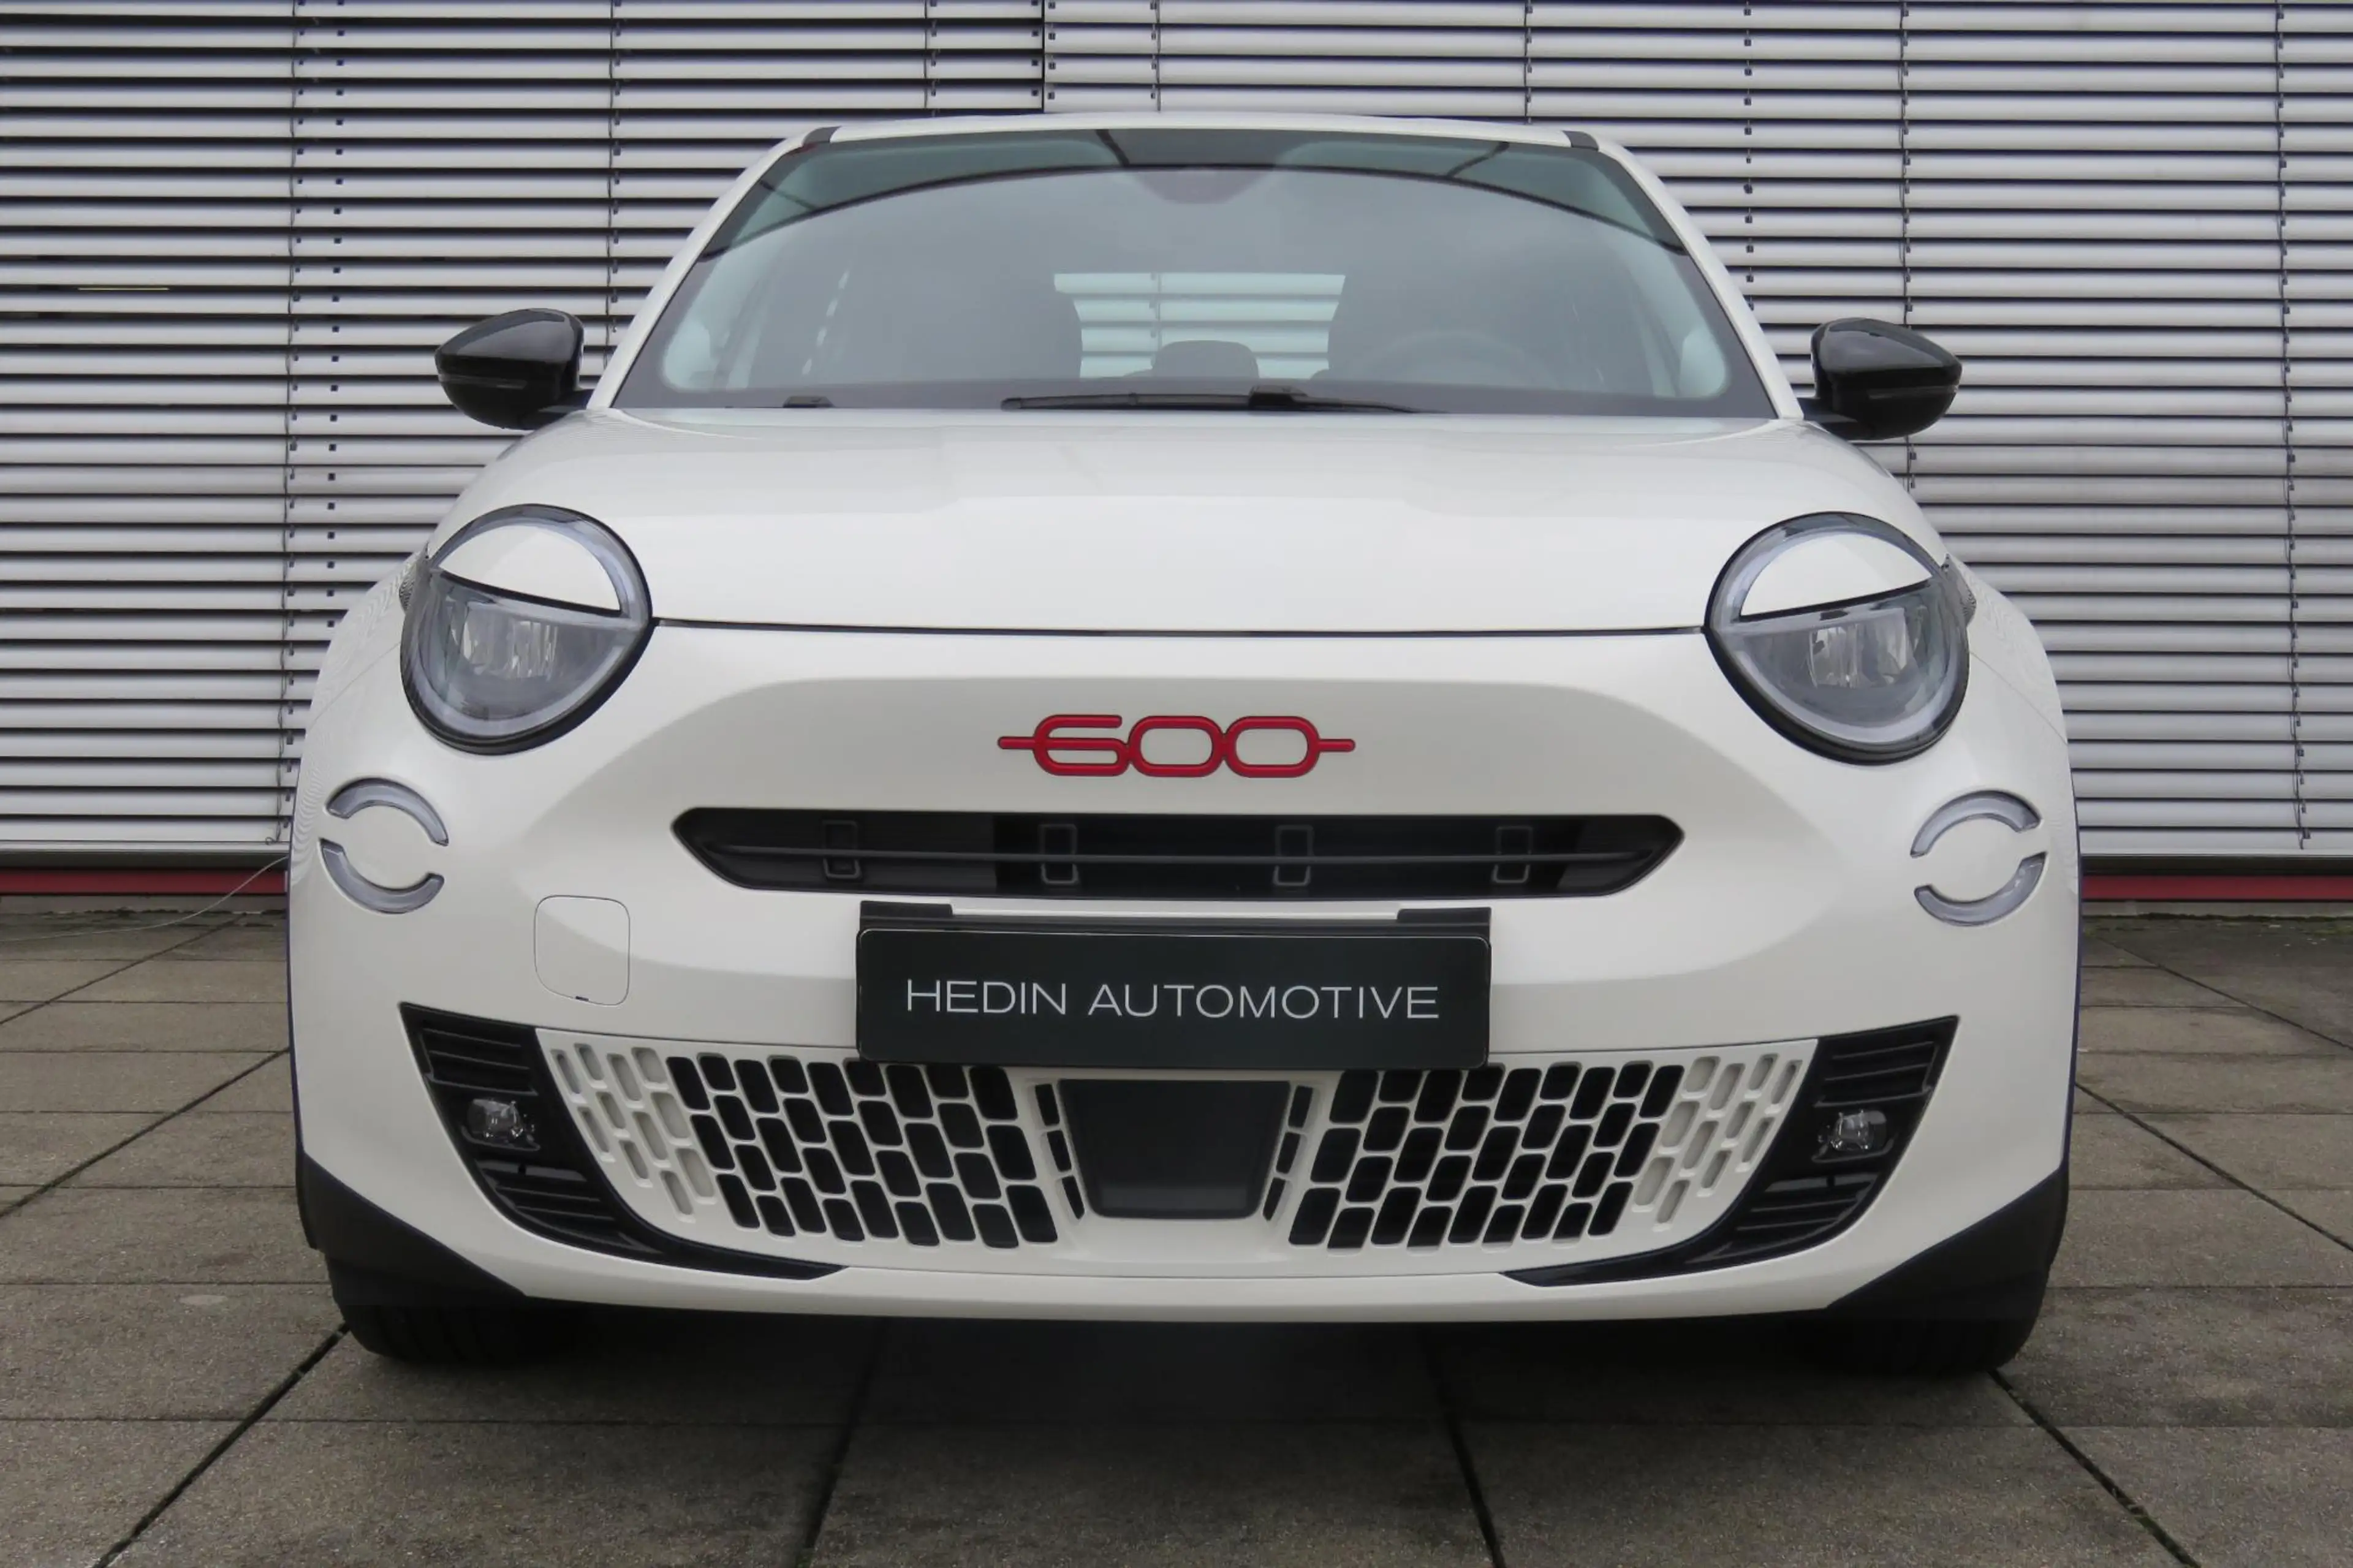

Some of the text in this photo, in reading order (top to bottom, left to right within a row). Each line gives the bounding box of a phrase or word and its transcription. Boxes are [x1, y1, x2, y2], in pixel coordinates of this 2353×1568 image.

[1032, 714, 1321, 778] 600
[907, 979, 1439, 1019] HEDIN AUTOMOTIVE
